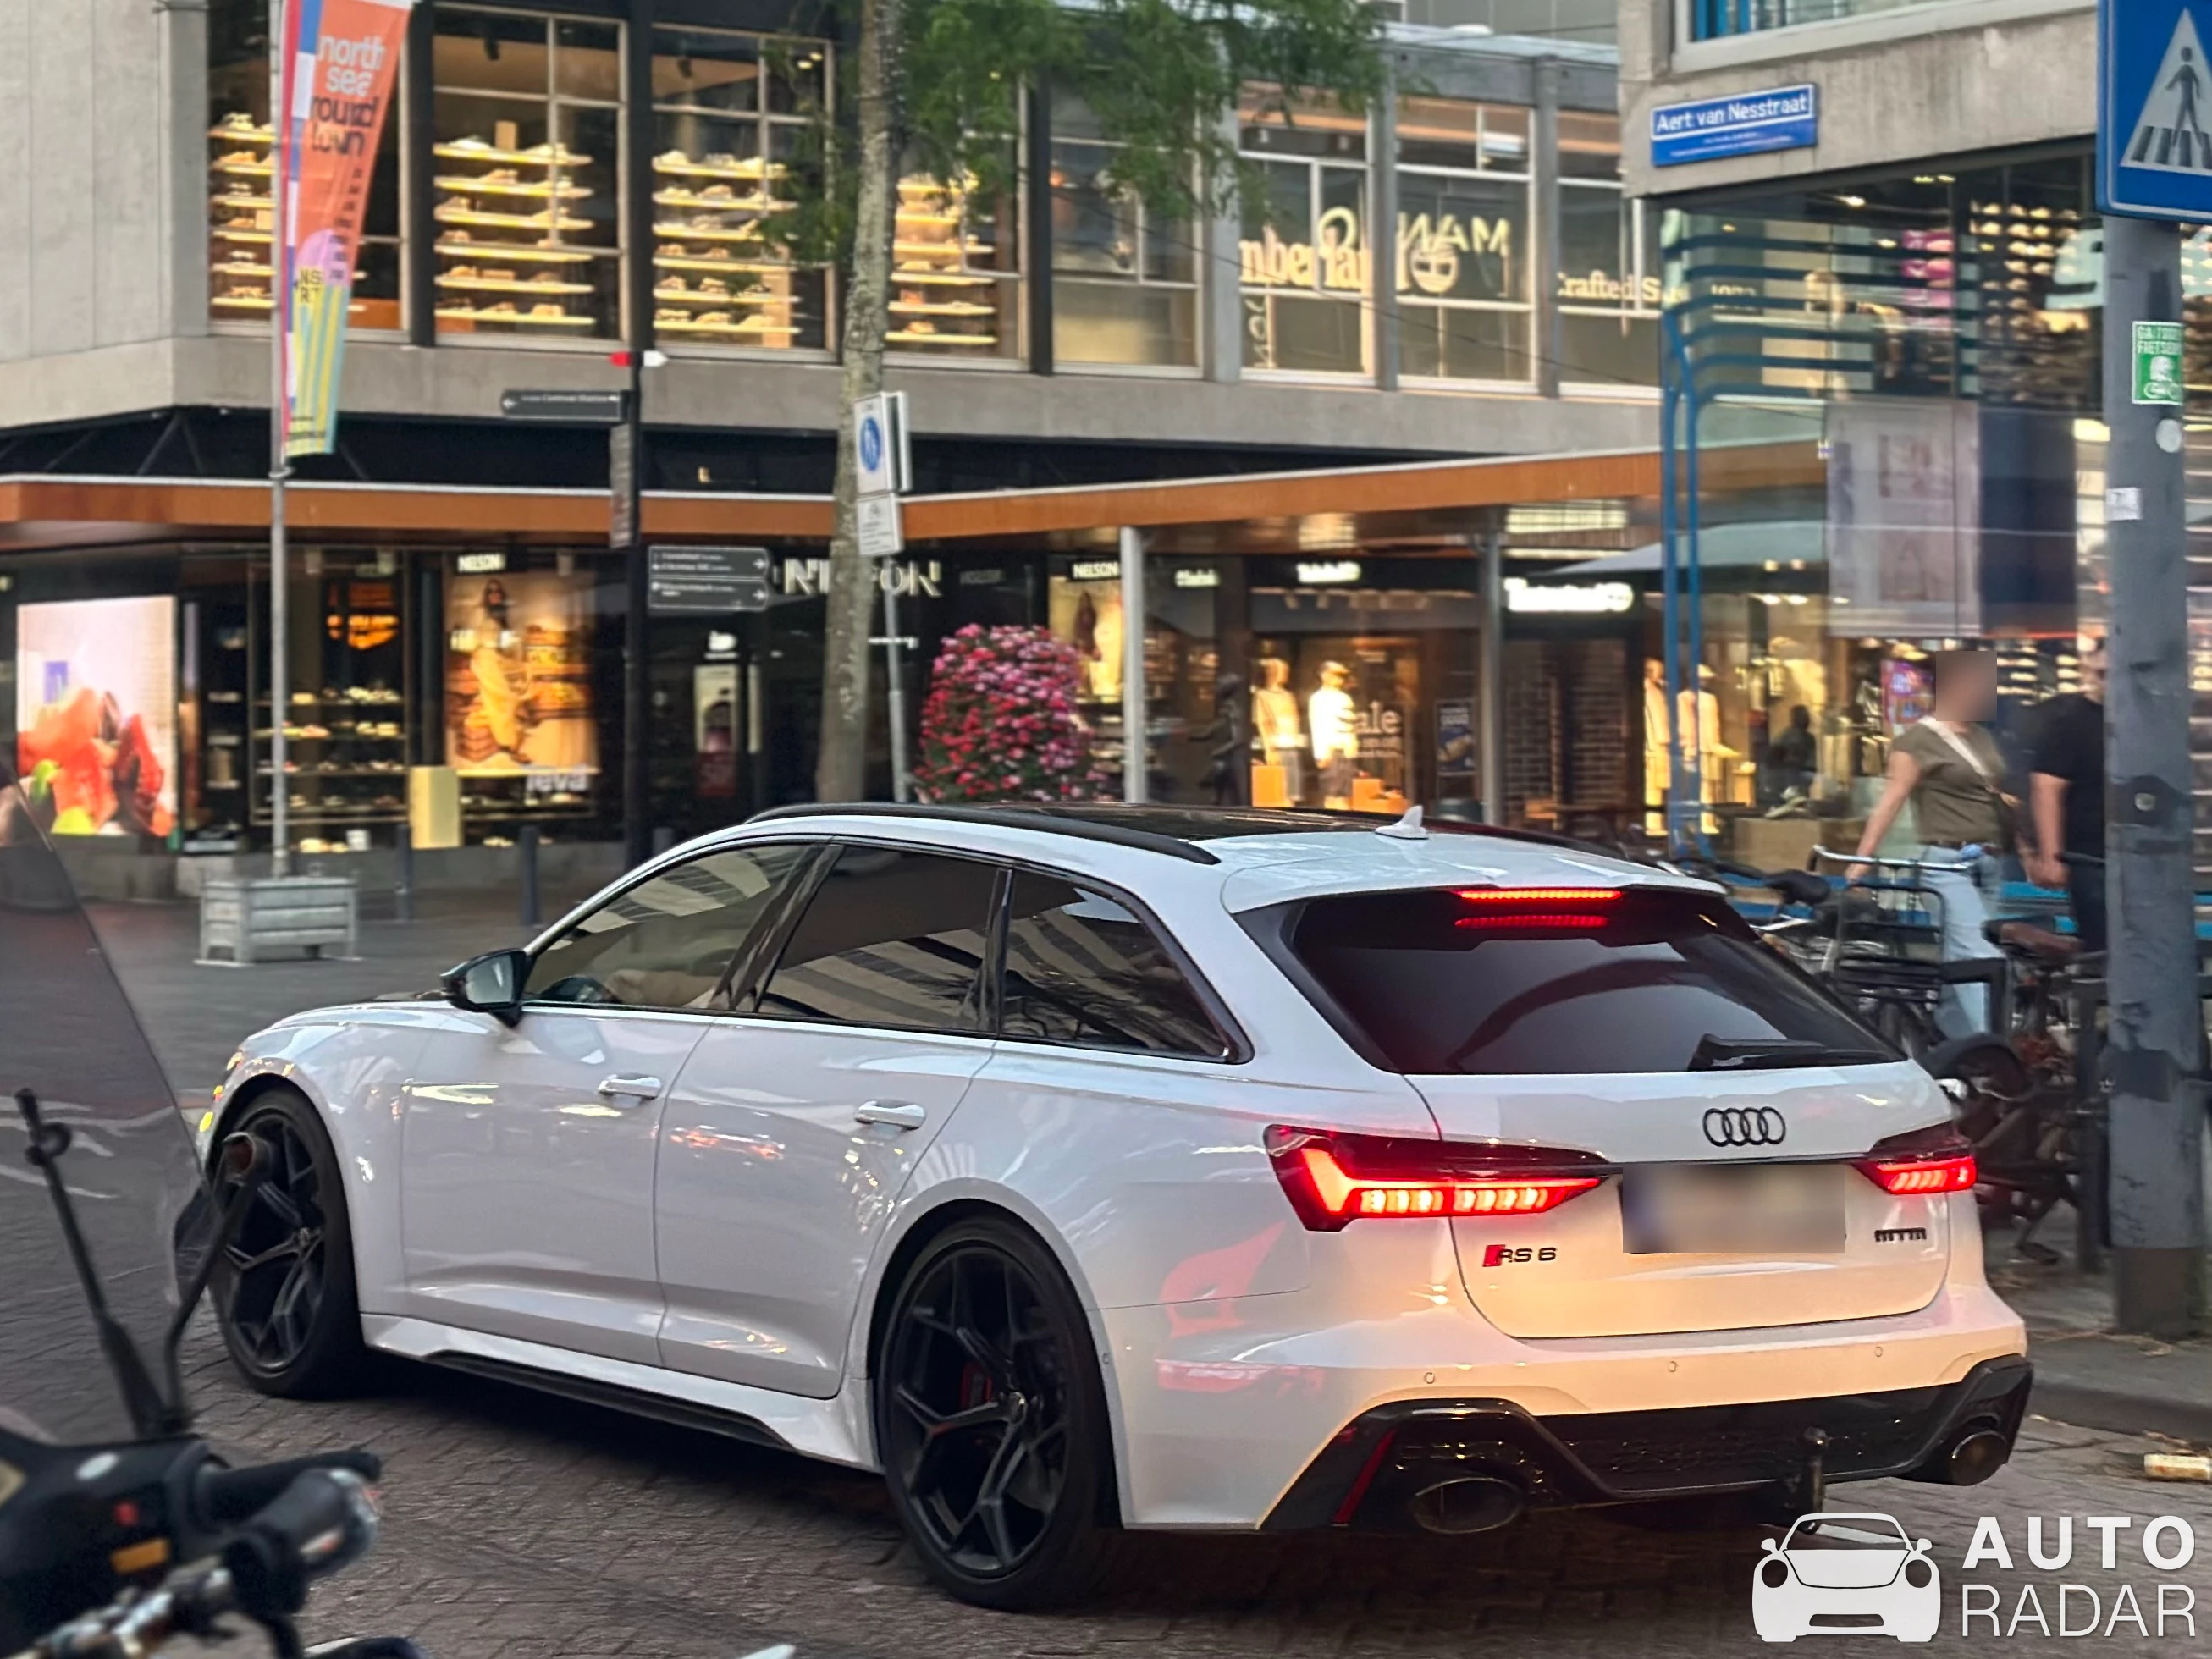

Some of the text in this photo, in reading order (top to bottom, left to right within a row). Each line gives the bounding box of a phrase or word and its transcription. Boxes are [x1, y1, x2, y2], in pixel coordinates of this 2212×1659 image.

[1657, 94, 1807, 132] Aert van Nesstraat
[1072, 561, 1118, 579] NELSON
[1355, 700, 1403, 734] ale
